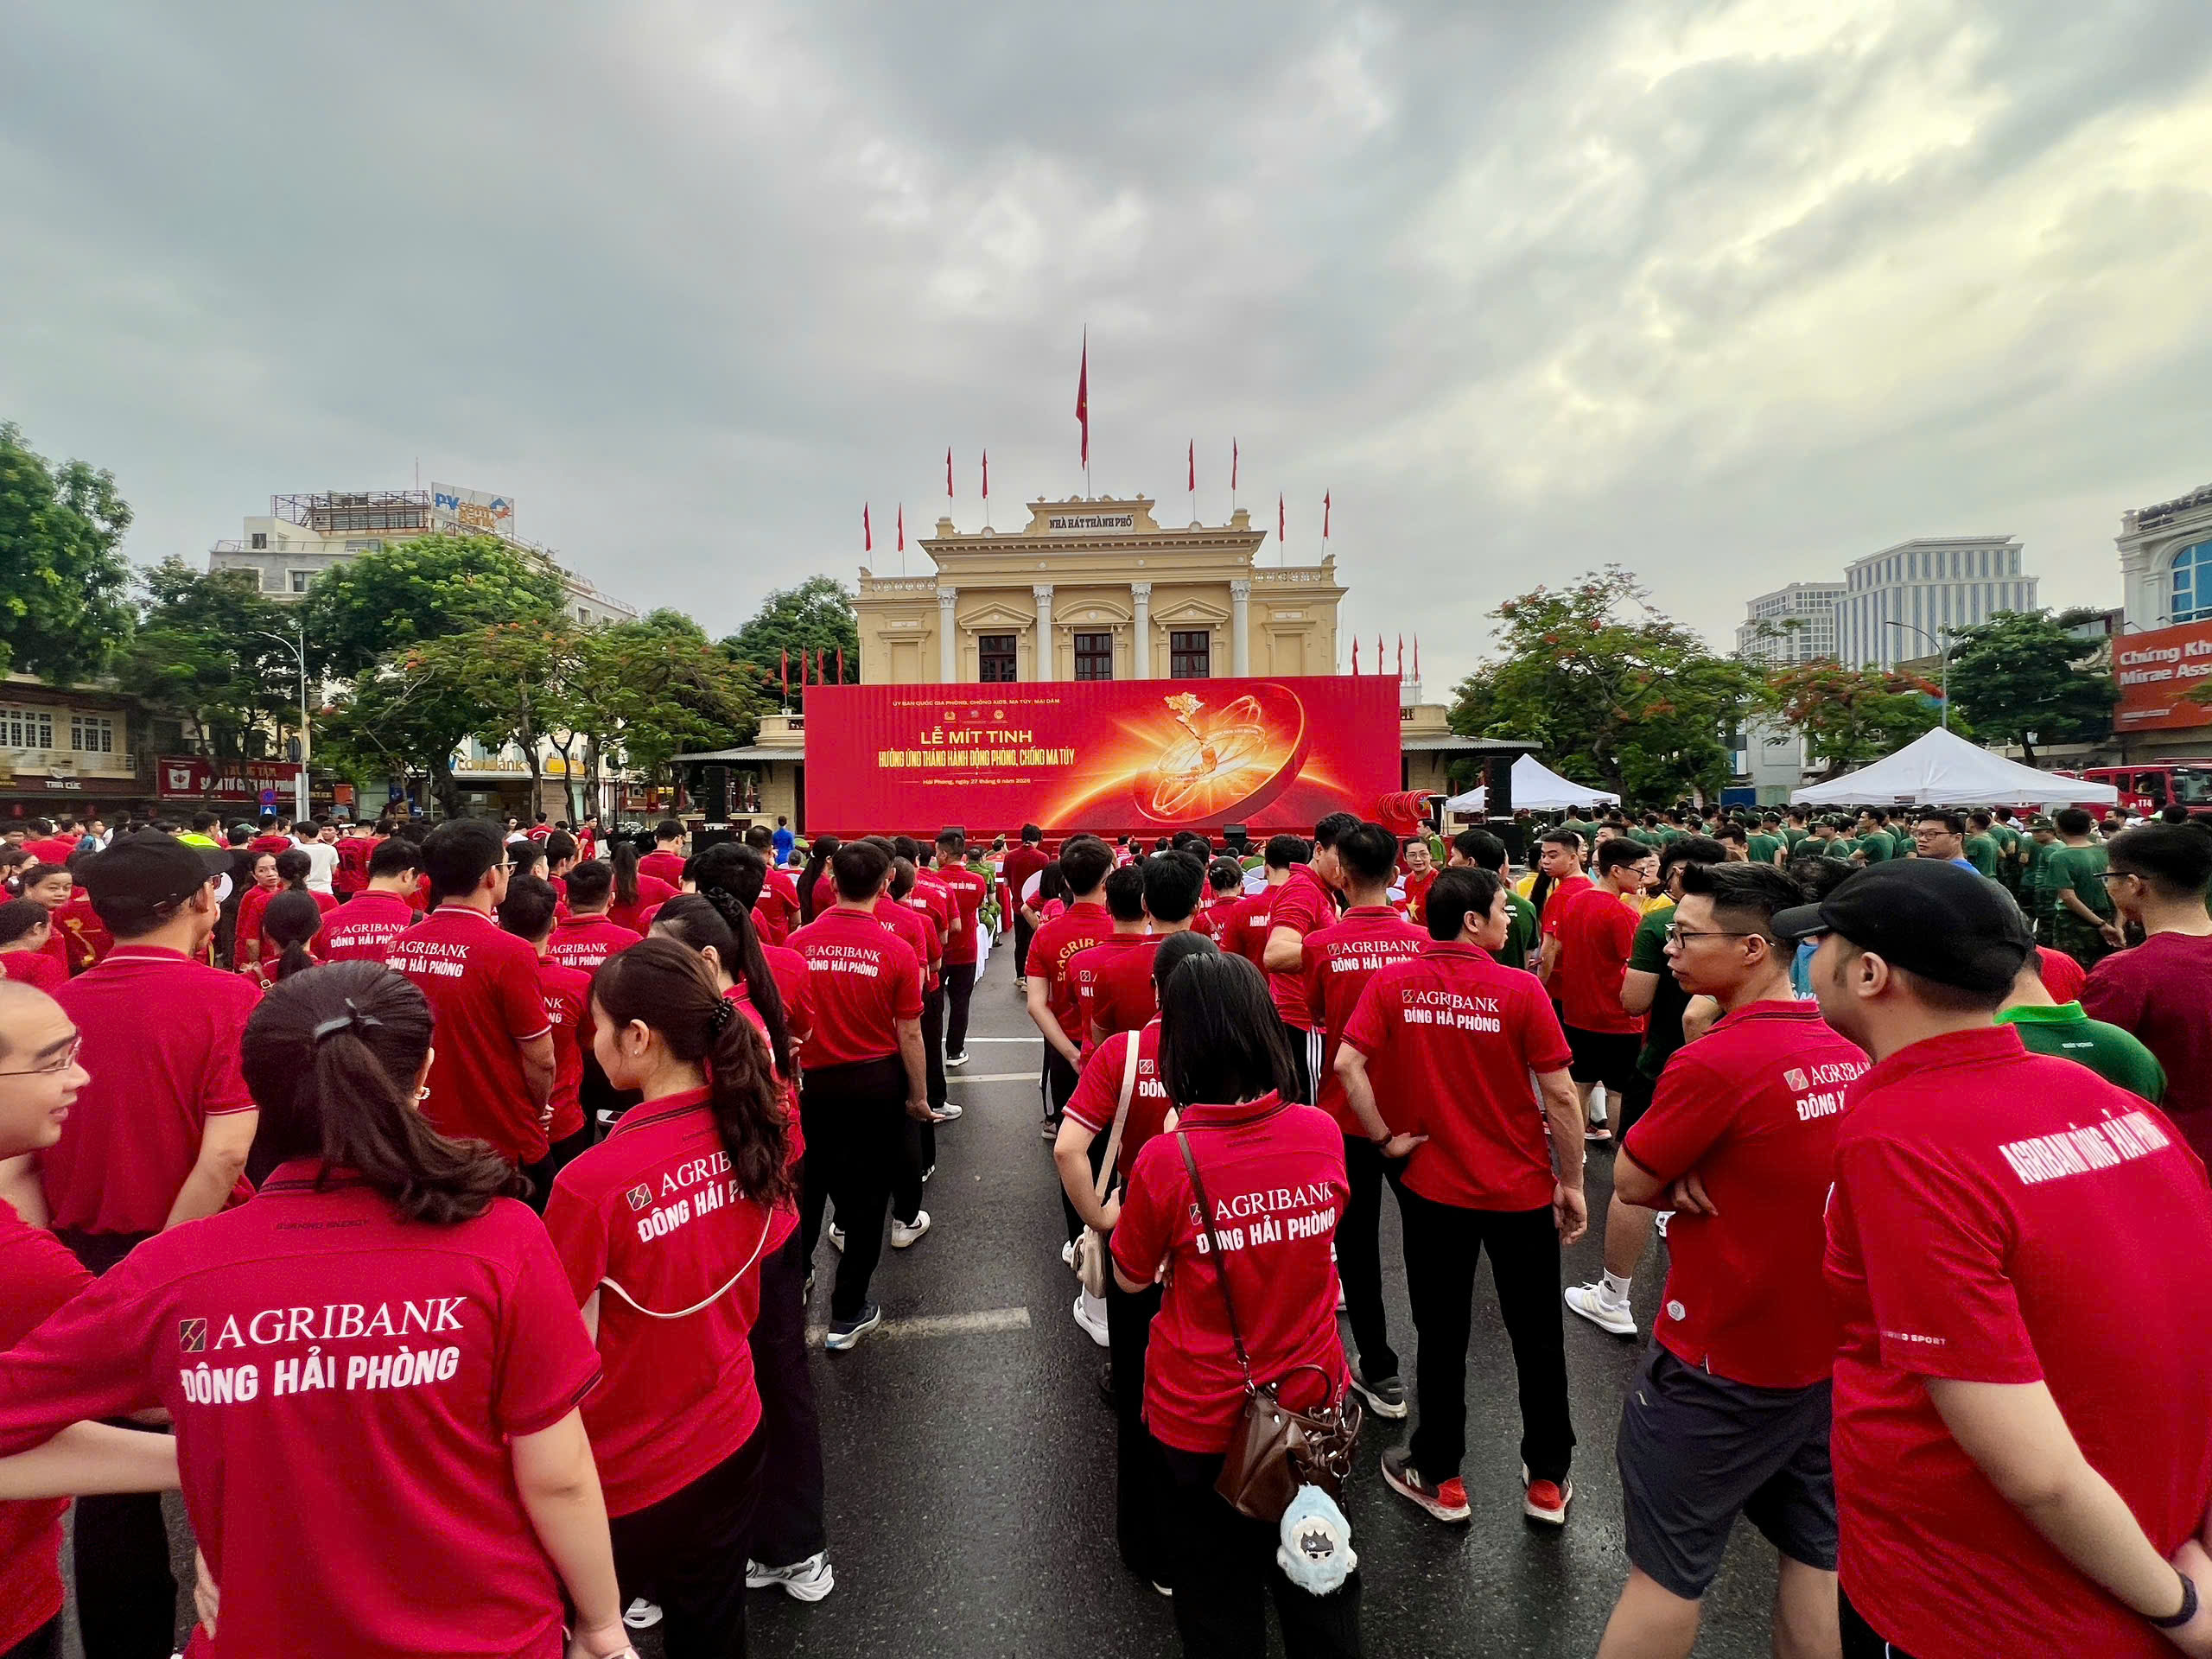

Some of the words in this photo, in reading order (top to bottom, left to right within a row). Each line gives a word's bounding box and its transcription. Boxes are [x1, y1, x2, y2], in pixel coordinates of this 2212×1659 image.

[435, 493, 460, 510] PV
[1050, 517, 1066, 529] NHÀ
[1068, 516, 1084, 528] HÁT
[1085, 516, 1114, 528] THÀNH
[1115, 515, 1134, 527] PHỐ
[2120, 646, 2180, 665] Chứng
[2120, 669, 2172, 685] Mirae
[2177, 664, 2212, 678] Ass
[920, 726, 944, 745] LỄ
[949, 728, 982, 744] MÍT
[986, 730, 1033, 744] TINH
[879, 747, 905, 767] HƯỞNG
[906, 748, 922, 767] ỨNG
[923, 748, 945, 767] THÁNG
[947, 747, 969, 766] HÀNH
[969, 747, 990, 769] ĐỘNG
[991, 747, 1019, 766] PHÒNG,
[1020, 745, 1045, 766] CHỐNG
[1046, 749, 1058, 766] MA
[1059, 746, 1075, 766] TÚY
[342, 923, 408, 934] AGRIBANK
[359, 933, 373, 945] HẢI
[397, 941, 470, 959] AGRIBANK
[549, 943, 608, 955] AGRIBANK
[816, 945, 881, 963] AGRIBANK
[1341, 939, 1421, 955] AGRIBANK
[409, 956, 427, 974] HẢI
[429, 958, 464, 977] PHÒNG
[562, 954, 577, 966] HẢI
[831, 957, 847, 972] HẢI
[848, 961, 879, 978] PHÒNG
[1331, 957, 1359, 973] ĐÔNG
[1363, 954, 1382, 969] HẢI
[1416, 990, 1500, 1013] AGRIBANK
[1436, 1007, 1455, 1026] HẢ
[1457, 1014, 1501, 1033] PHÒNG
[1811, 1061, 1872, 1086] AGRIBAN
[1139, 1078, 1166, 1097] ĐÔN
[1796, 1092, 1837, 1121] ĐÔNG
[660, 1150, 732, 1198] AGRIB
[637, 1199, 691, 1243] ĐÔNG
[694, 1180, 724, 1217] HẢI
[1215, 1181, 1335, 1221] AGRIBANK
[1196, 1227, 1244, 1255] ĐNG
[1249, 1214, 1281, 1246] HẢI
[1288, 1206, 1336, 1241] PHÒNG
[213, 1296, 468, 1351] AGRIBANK
[180, 1362, 258, 1404] ĐÔNG
[274, 1345, 335, 1396] HẢI
[346, 1345, 461, 1390] PHÒNG
